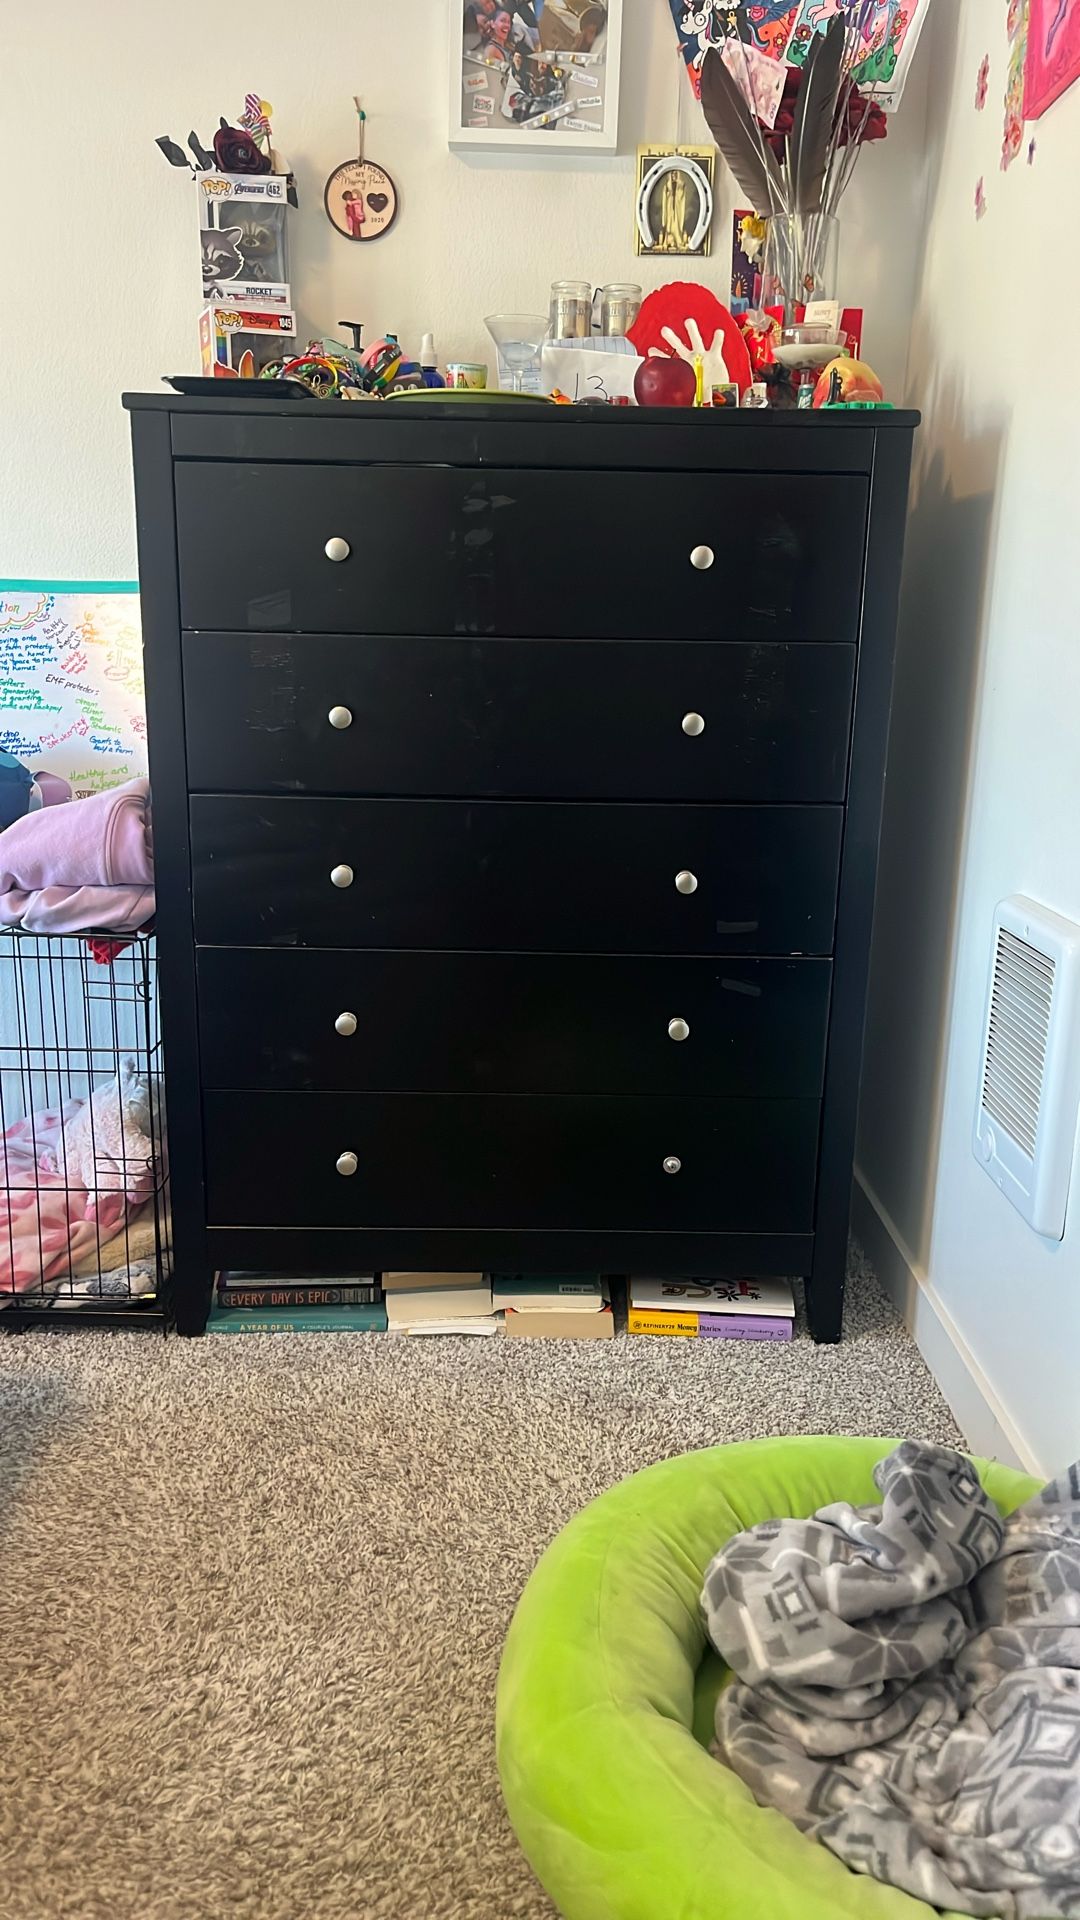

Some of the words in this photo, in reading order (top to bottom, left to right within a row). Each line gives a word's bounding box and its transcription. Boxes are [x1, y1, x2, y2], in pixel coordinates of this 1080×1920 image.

[201, 179, 232, 196] POP!
[268, 184, 281, 195] 462
[245, 287, 273, 296] ROCKET
[214, 311, 242, 328] POP!
[248, 314, 273, 329] Disney
[278, 316, 292, 329] 1045
[45, 673, 66, 685] EMF
[111, 764, 129, 774] and
[230, 1293, 265, 1306] EVERY
[271, 1292, 291, 1305] DAY
[295, 1291, 305, 1304] IS
[308, 1291, 331, 1304] EPIC
[677, 1323, 698, 1332] Money
